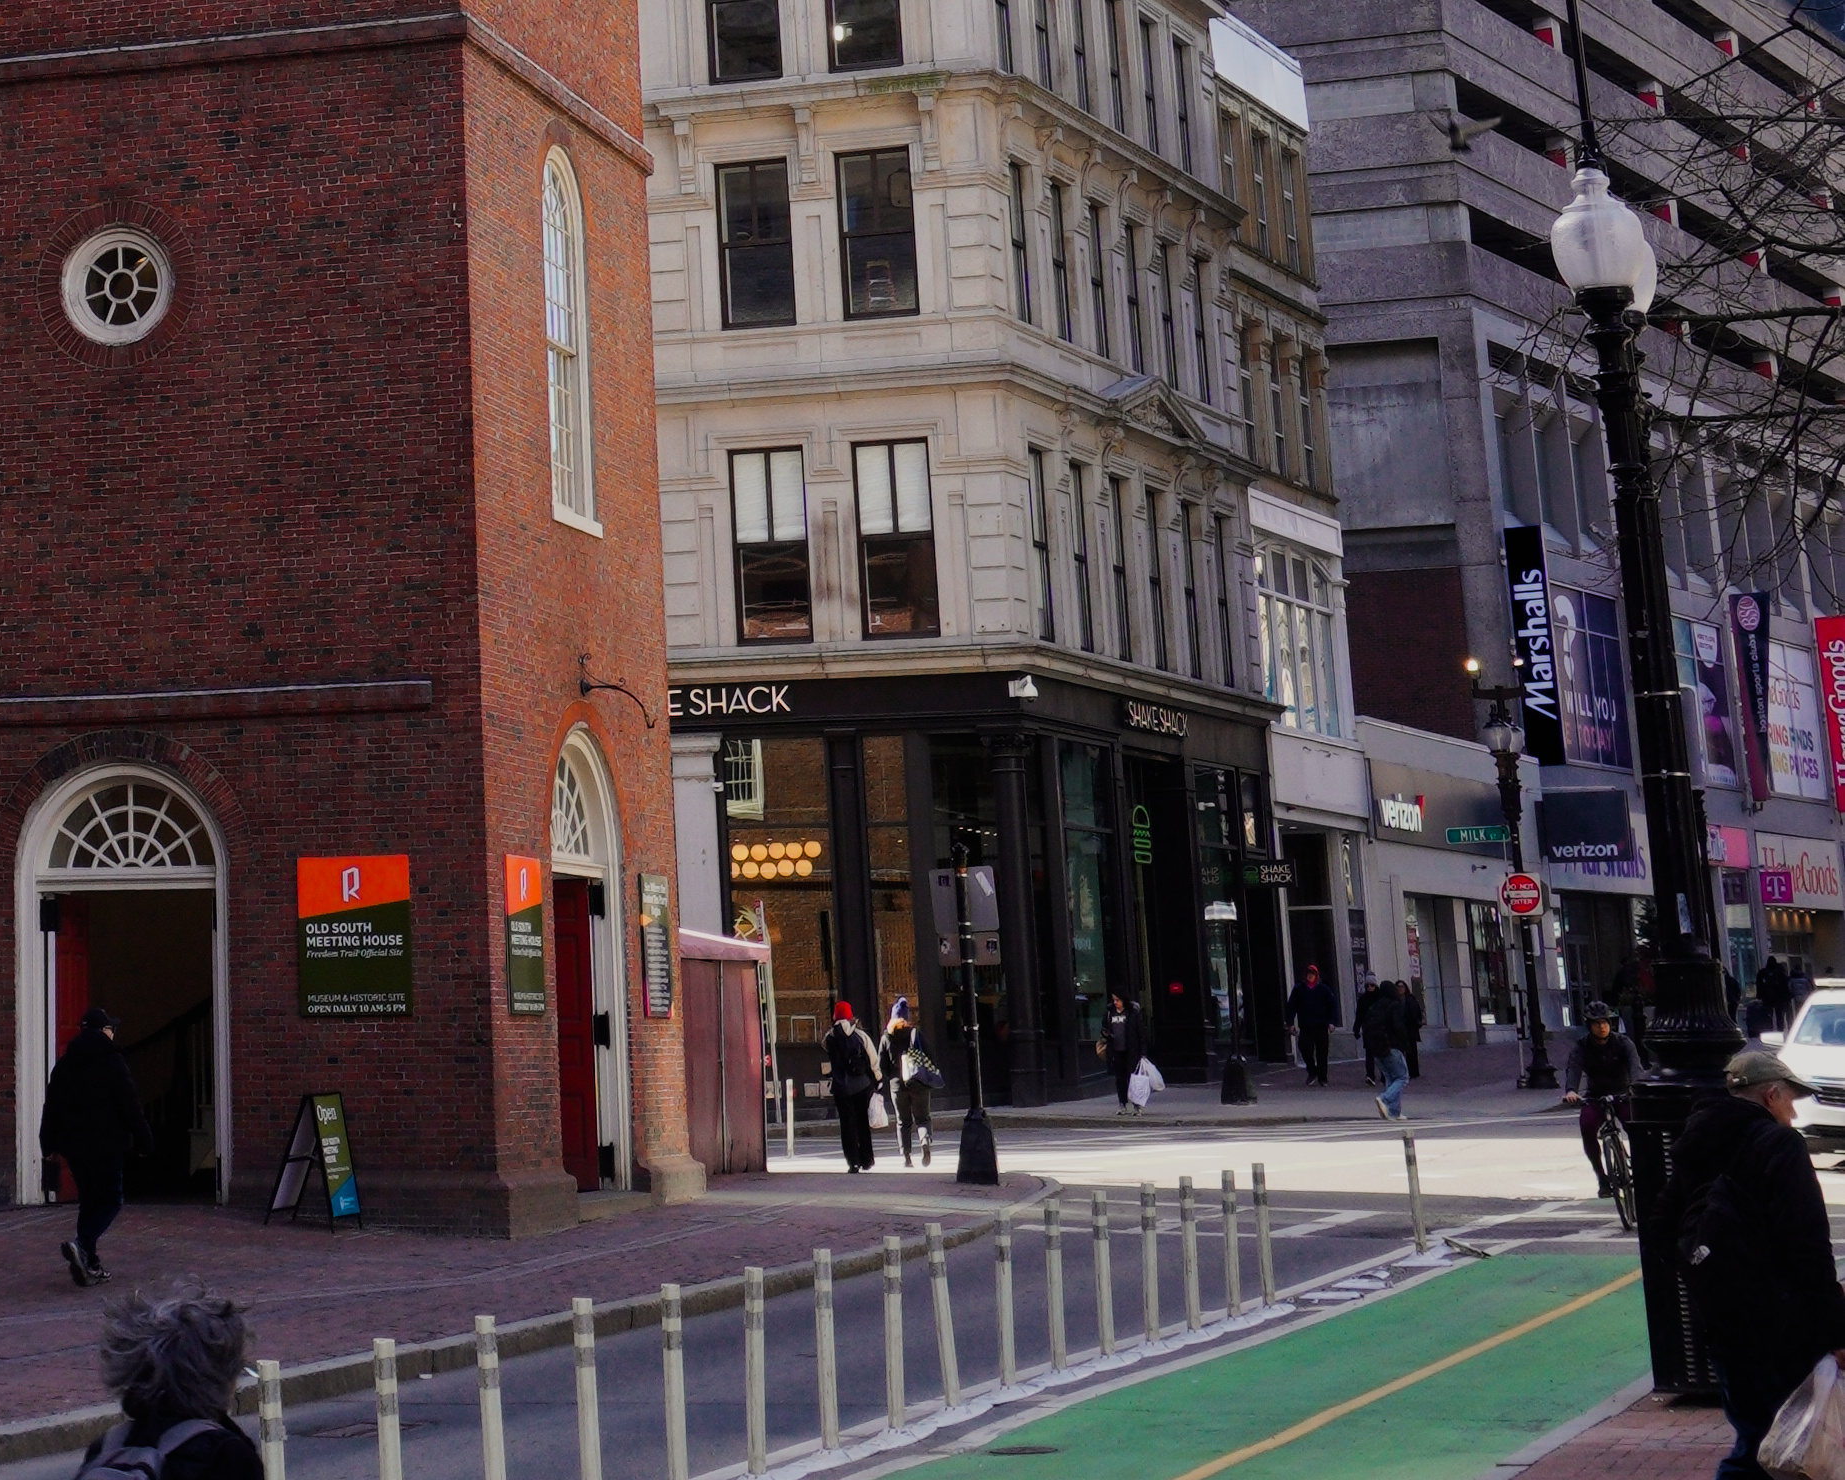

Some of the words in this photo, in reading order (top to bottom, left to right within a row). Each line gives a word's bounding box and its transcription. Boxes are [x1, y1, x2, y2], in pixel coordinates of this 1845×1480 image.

[1513, 568, 1557, 720] Marshalls
[1748, 633, 1759, 662] clubs
[689, 684, 792, 716] SHACK
[1595, 695, 1616, 722] YOU
[1756, 697, 1767, 733] boston
[1128, 700, 1158, 732] SHAKE
[1158, 709, 1190, 737] SHACK
[1381, 793, 1423, 833] verizon
[1460, 828, 1486, 842] MILK
[1552, 841, 1619, 858] verizon
[1259, 864, 1291, 874] SHAKE
[1260, 873, 1293, 884] SHACK
[1519, 882, 1534, 890] NOT
[306, 923, 329, 934] OLD
[331, 922, 371, 933] SOUTH
[306, 936, 360, 947] MEETING
[363, 934, 403, 946] HOUSE
[306, 950, 339, 958] Freedom
[360, 948, 388, 959] Official
[388, 948, 404, 957] Site
[307, 993, 341, 1003] MUSEUM
[342, 993, 349, 1003] &
[350, 993, 387, 1002] HISTORIC
[388, 993, 405, 1002] SITE
[307, 1005, 332, 1013] OPEN
[333, 1004, 358, 1013] DAILY
[359, 1004, 369, 1013] 10
[393, 1004, 406, 1013] PM
[317, 1105, 337, 1125] Open
